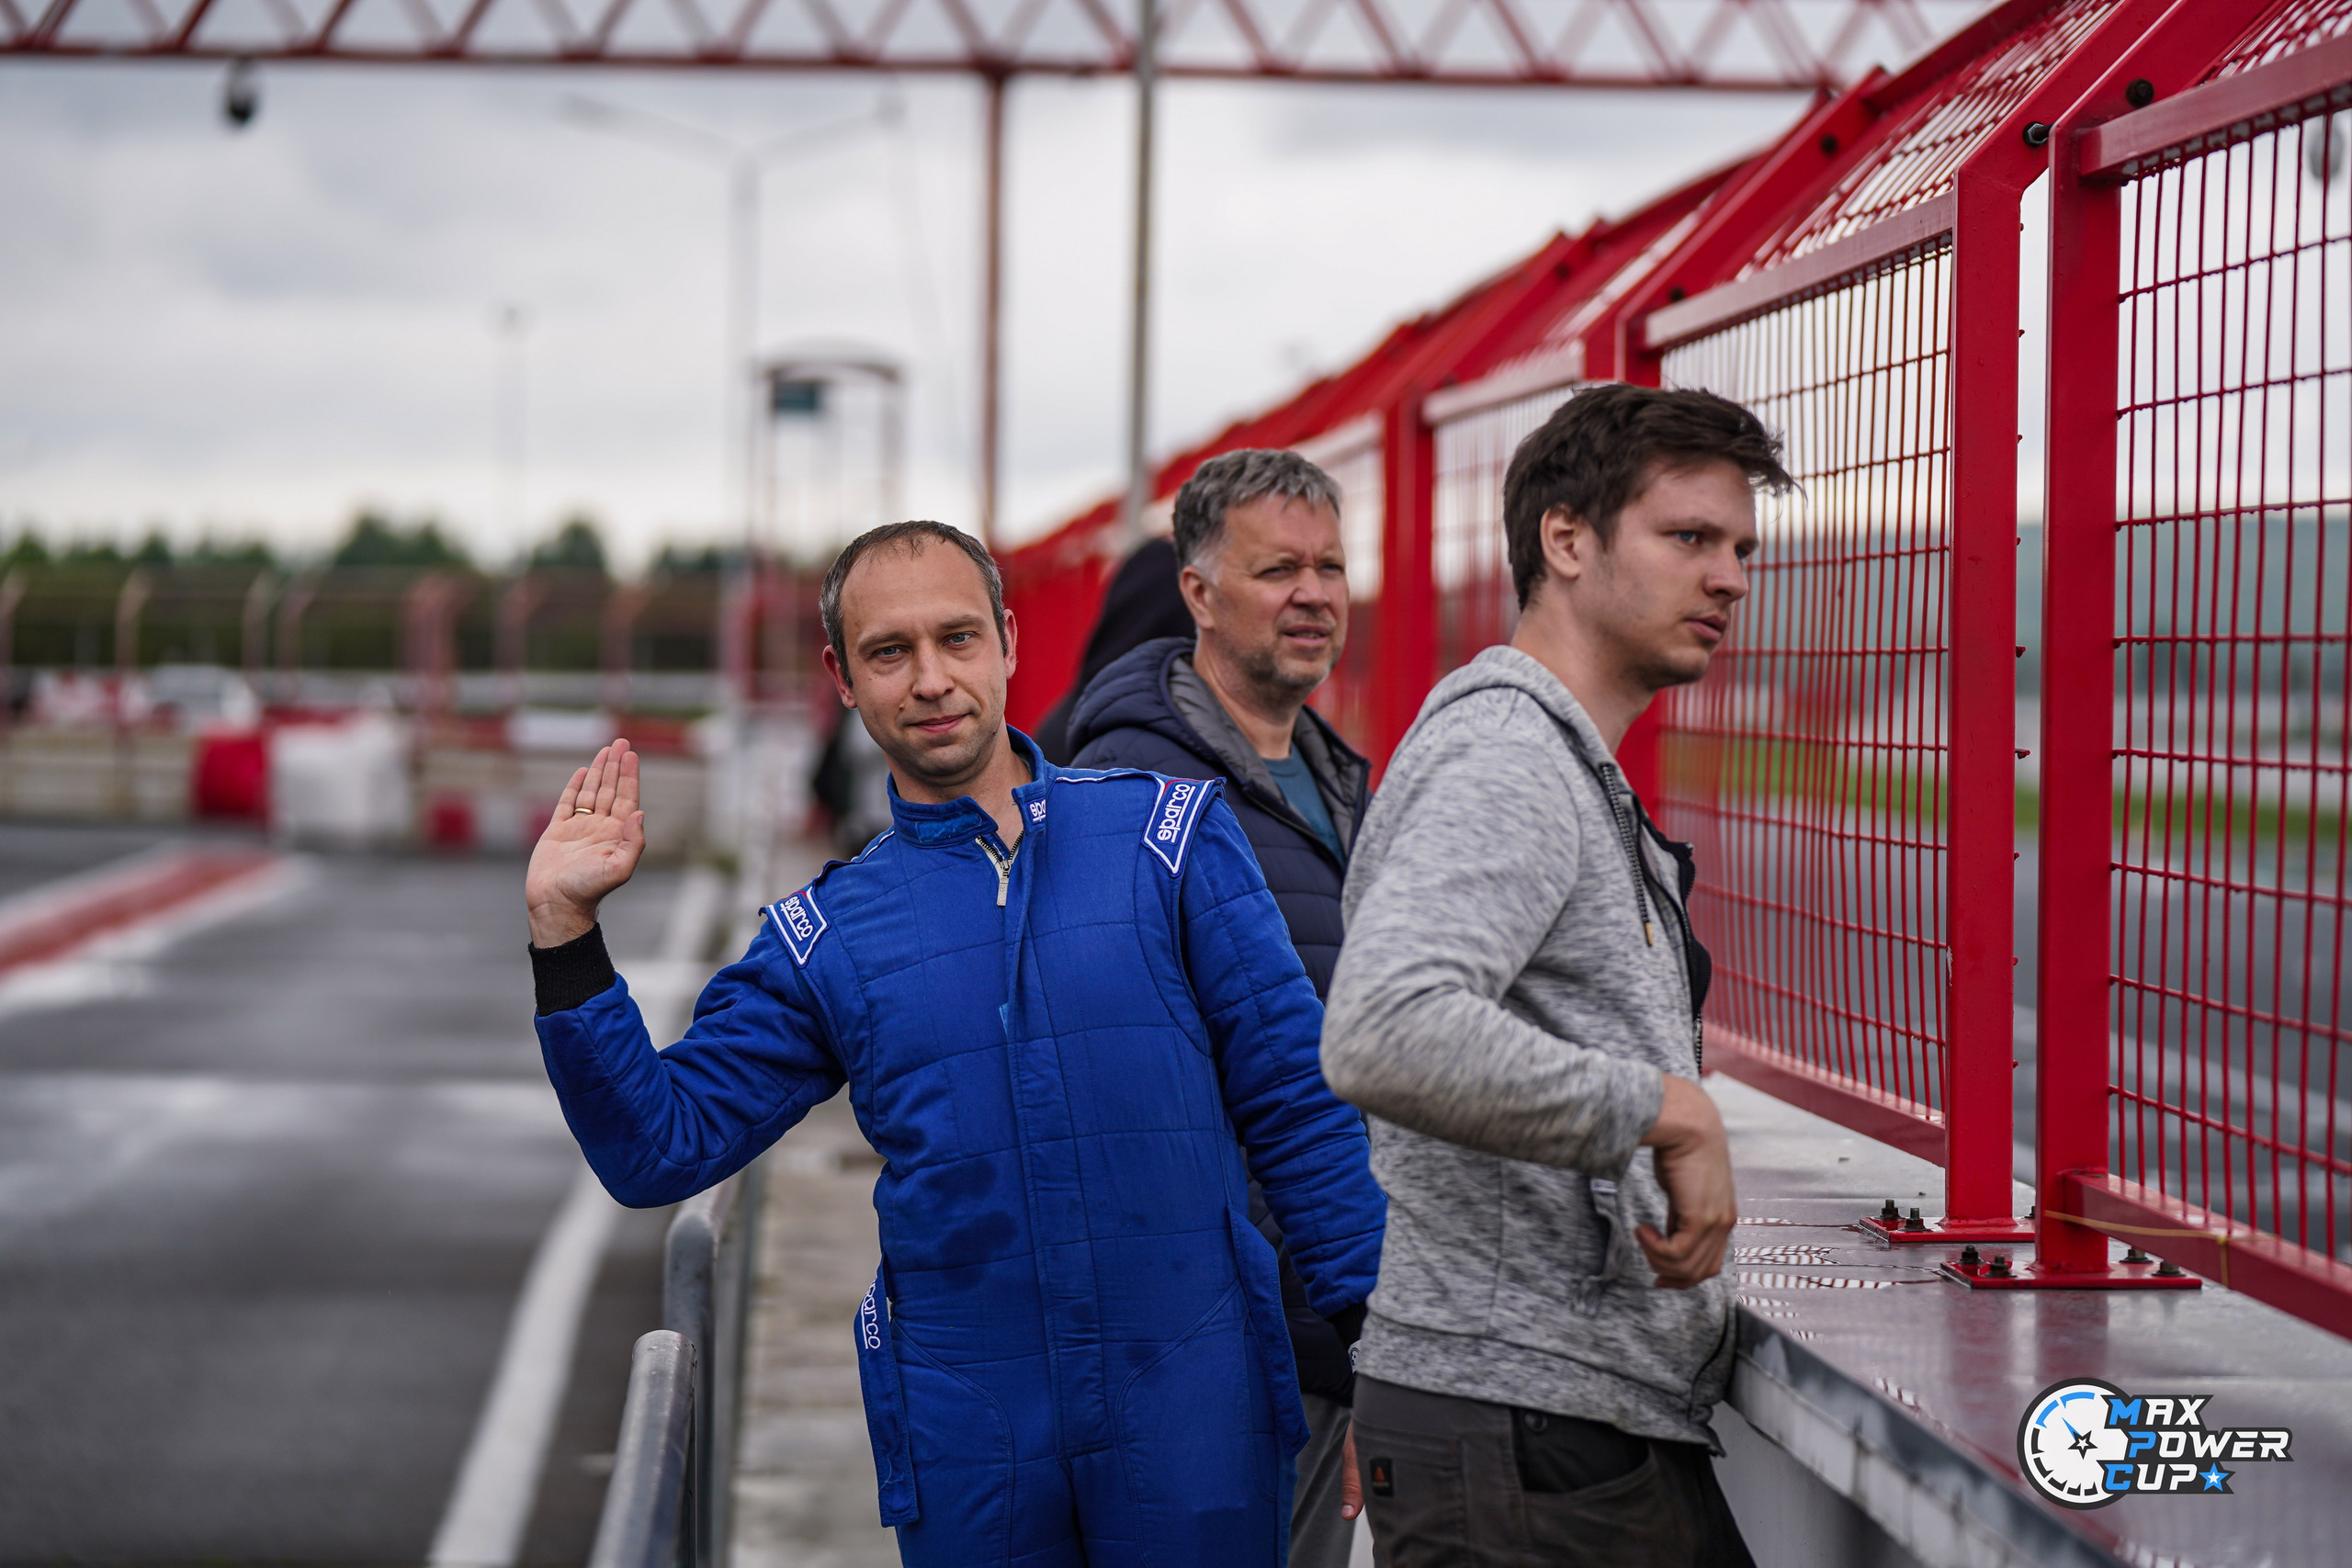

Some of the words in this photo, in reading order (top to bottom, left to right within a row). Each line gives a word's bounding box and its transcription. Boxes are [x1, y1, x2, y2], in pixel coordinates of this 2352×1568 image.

[1030, 799, 1046, 821] spa
[1158, 784, 1192, 841] sparco
[780, 896, 813, 940] sparco
[863, 1282, 881, 1349] parco
